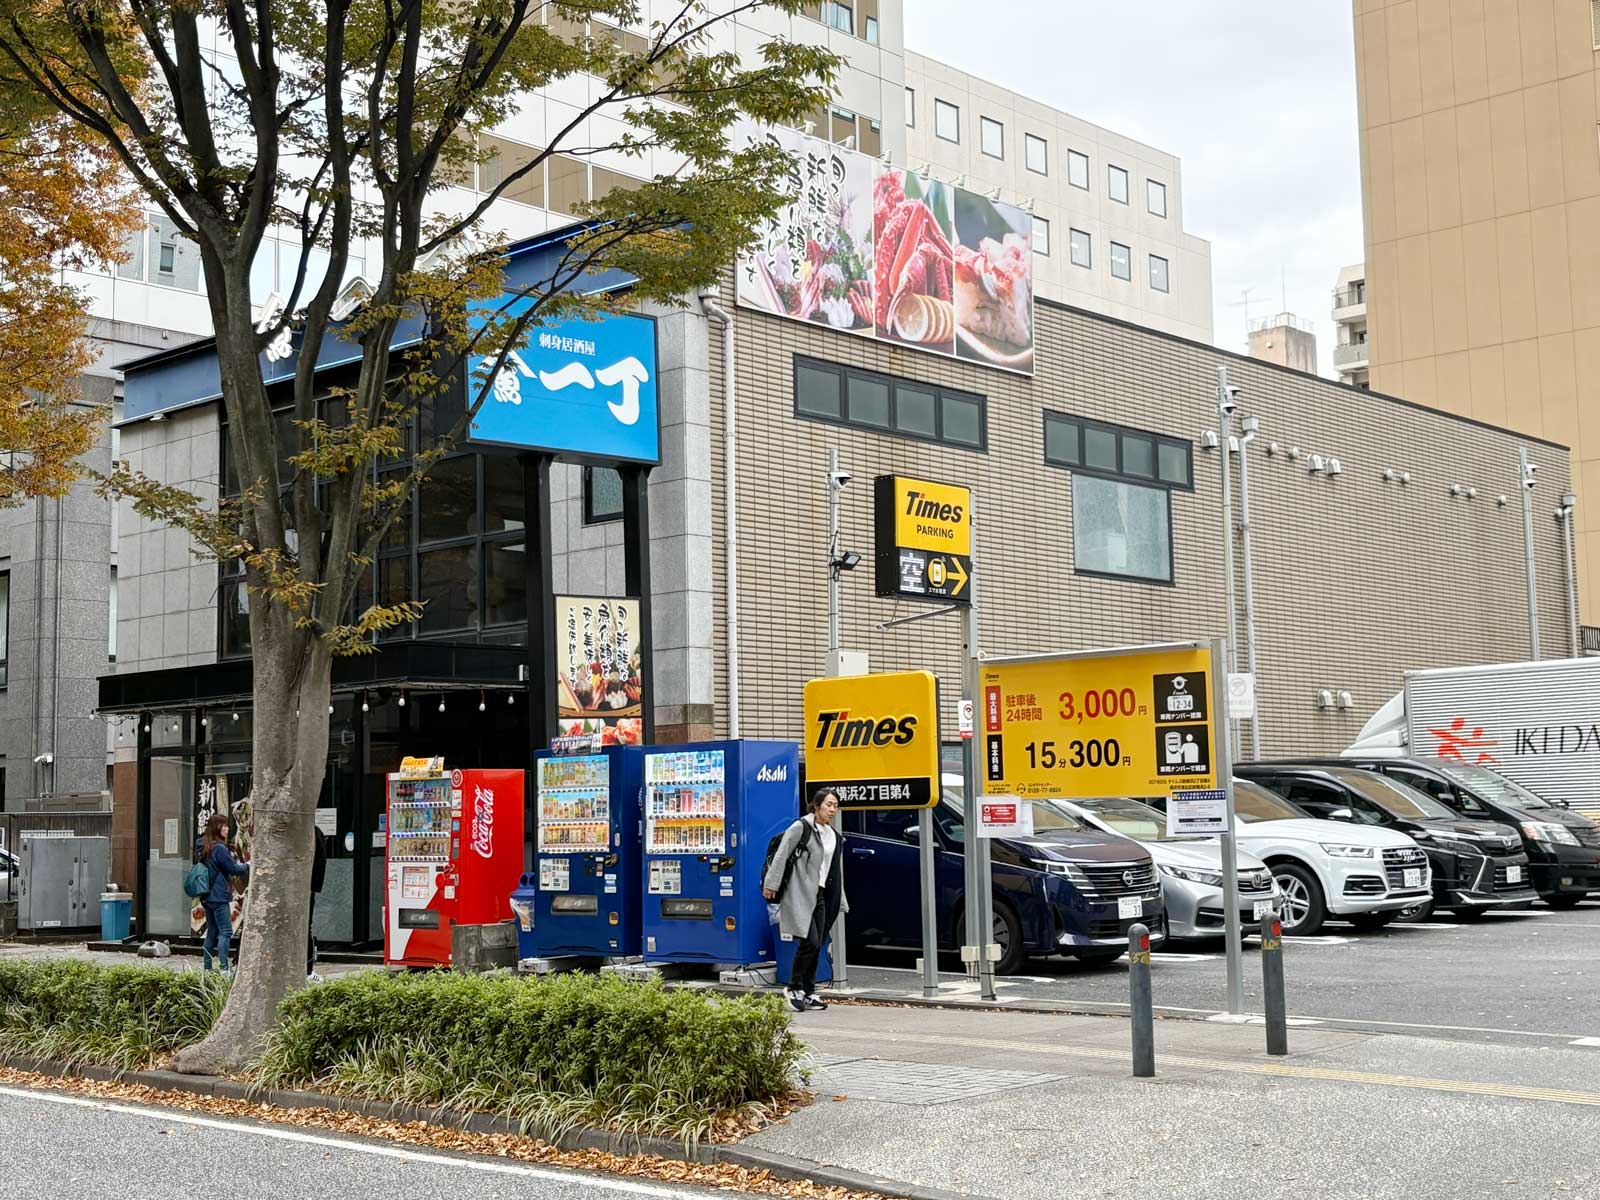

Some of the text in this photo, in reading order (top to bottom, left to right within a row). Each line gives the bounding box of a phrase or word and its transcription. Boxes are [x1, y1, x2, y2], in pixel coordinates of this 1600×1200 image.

[539, 332, 596, 356] 刺身居酒屋
[906, 490, 963, 523] Times
[916, 524, 954, 539] PARKING
[899, 552, 925, 593] 空
[1005, 694, 1037, 708] 駐車後
[1006, 707, 1043, 722] 24時間
[815, 711, 917, 749] Times
[1515, 725, 1600, 756] IKEDA
[757, 764, 787, 782] Asahi
[829, 783, 911, 801] 横浜2丁目第4
